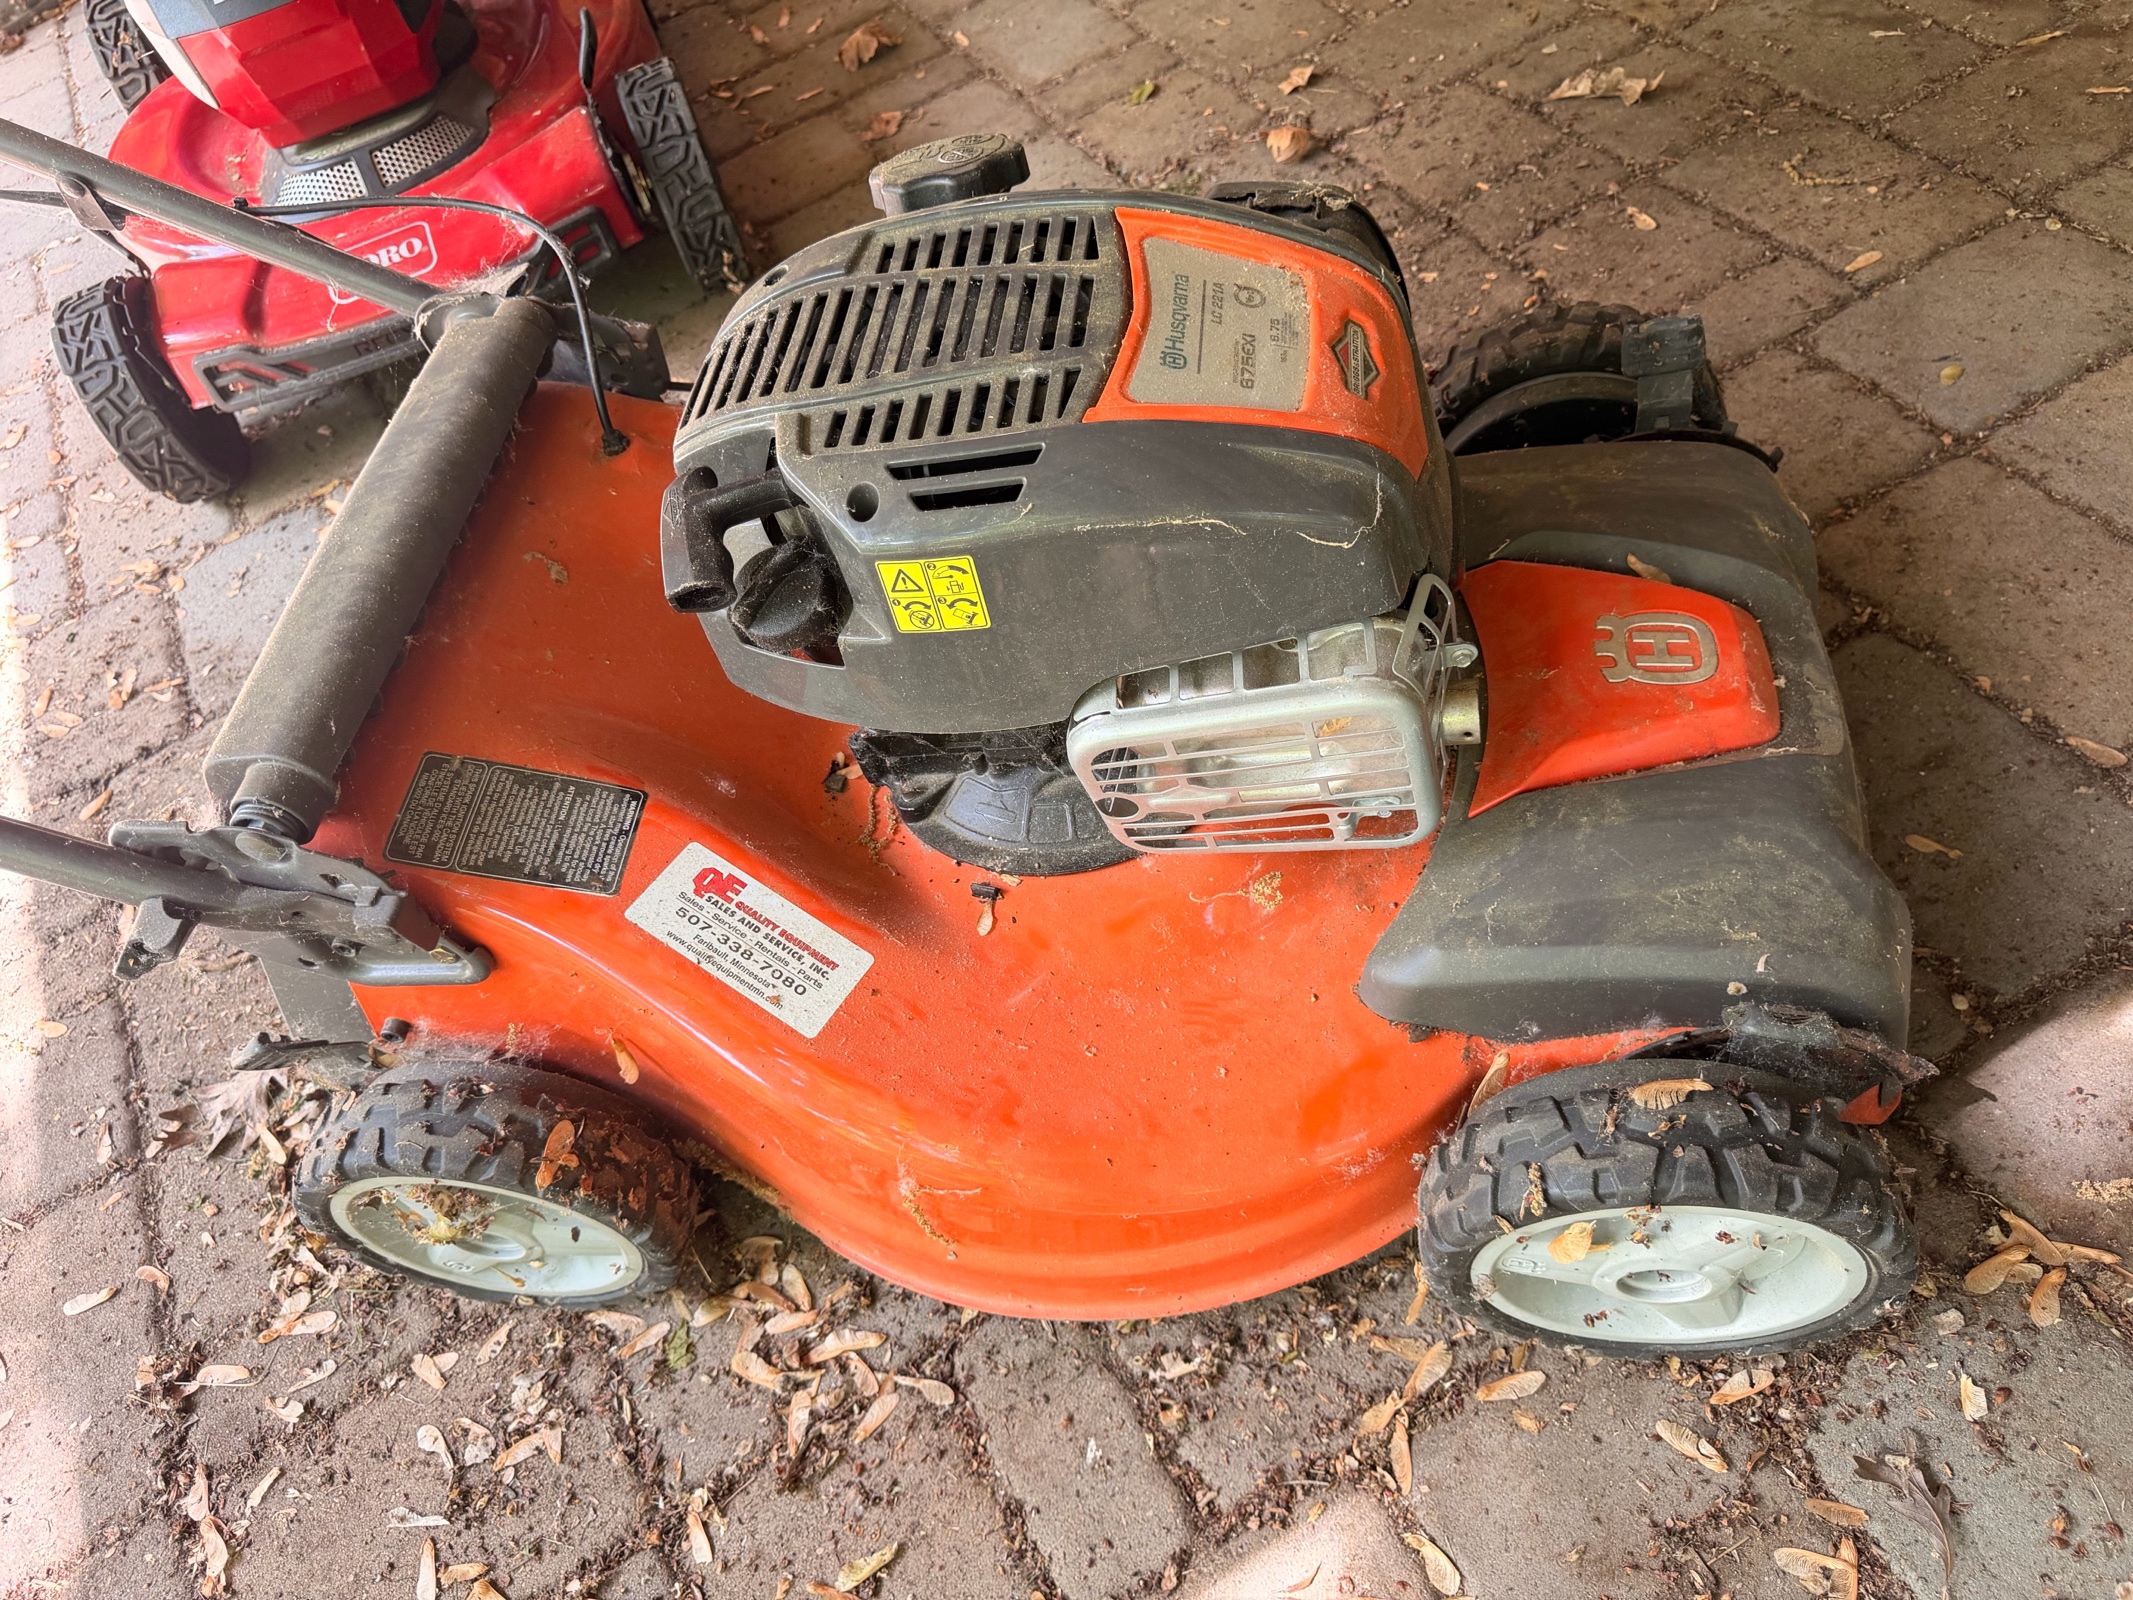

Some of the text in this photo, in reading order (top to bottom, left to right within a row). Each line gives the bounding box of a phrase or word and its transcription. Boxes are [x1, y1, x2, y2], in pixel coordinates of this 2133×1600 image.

[362, 237, 423, 267] RO
[1165, 274, 1190, 352] Husqvarna
[1211, 282, 1224, 326] LC 221A
[432, 764, 475, 862] COLIES WITH THE CANADIAN
[440, 768, 482, 861] THIS SPARK IGNITION SYSTEM
[442, 778, 461, 812] STANDARD
[558, 785, 575, 820] ATTENTION
[622, 800, 637, 830] WARNING
[599, 793, 630, 874] equipment may create sparks
[611, 834, 626, 863] Operation
[606, 870, 615, 881] this
[673, 905, 808, 997] 507-338-7080
[677, 890, 706, 911] Sales
[710, 912, 748, 939] Service
[753, 940, 791, 967] Rentals
[796, 968, 824, 989] Parts
[691, 933, 772, 988] Faribault, Minnesota
[704, 894, 832, 980] SALES AND SERVICE, INC.
[732, 899, 839, 972] QUALITY EQUIPMENT
